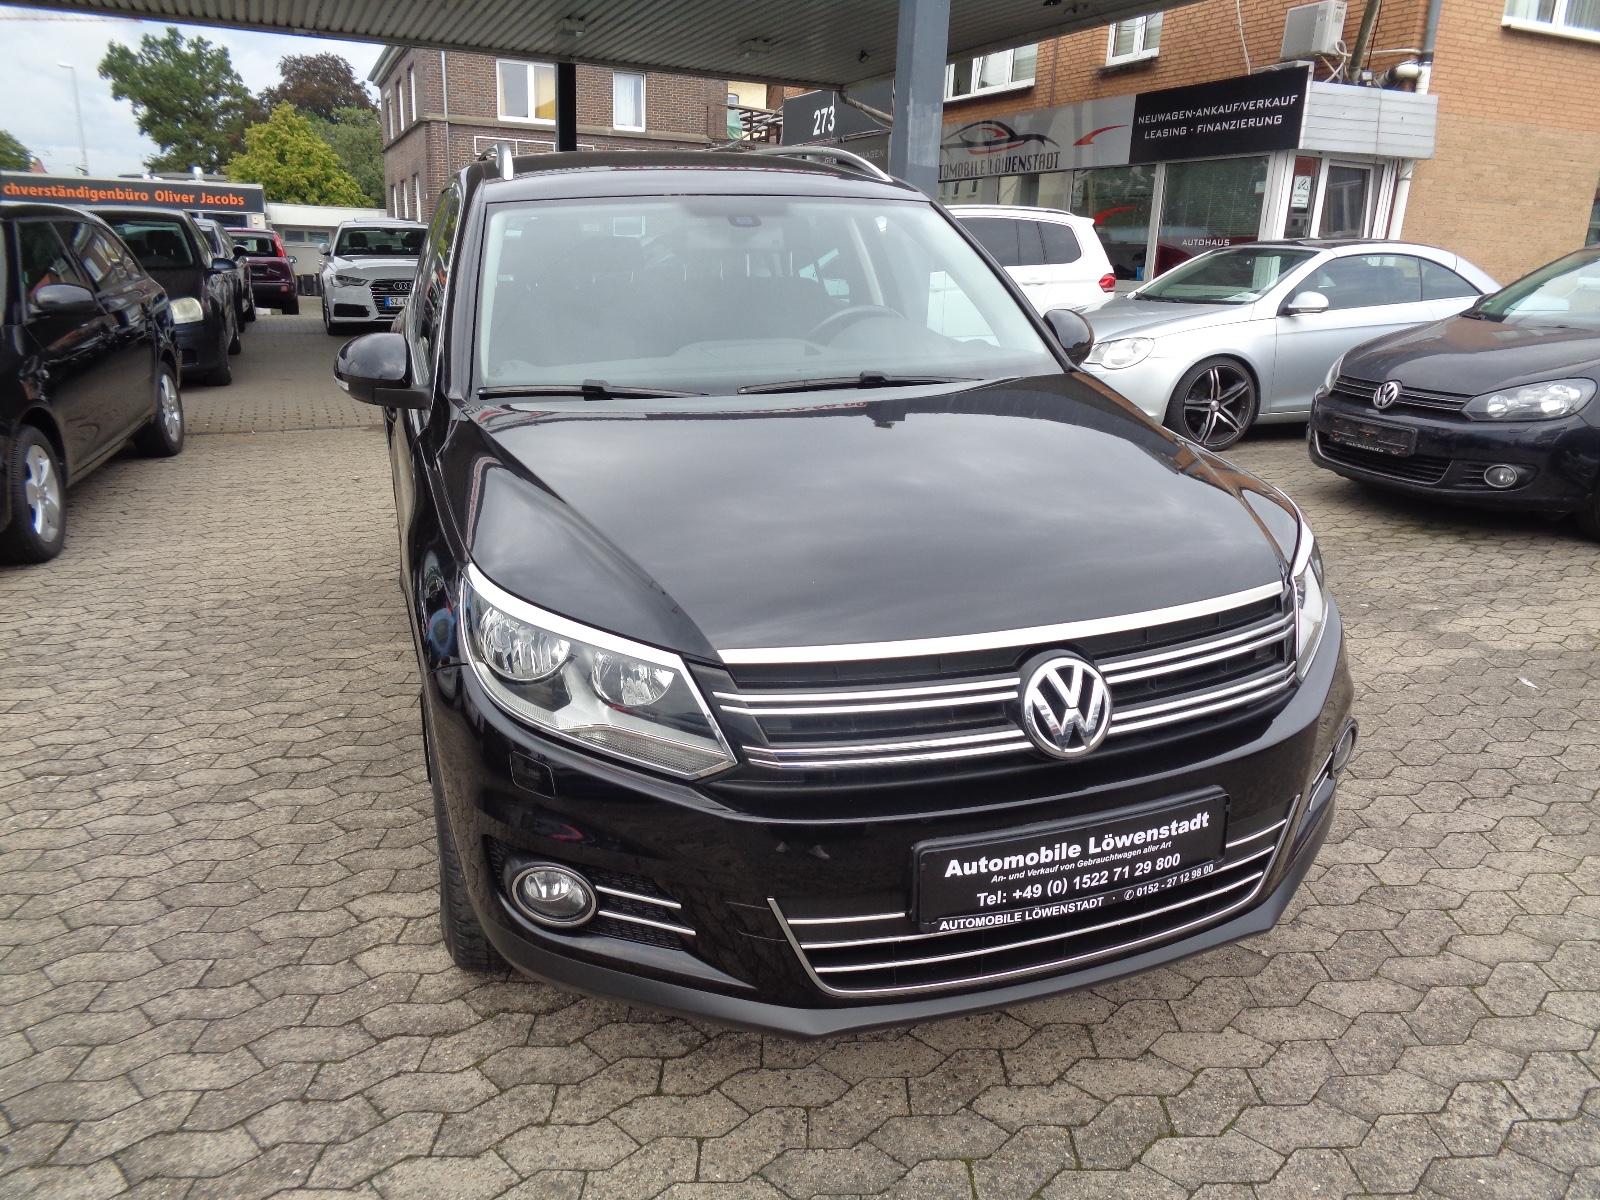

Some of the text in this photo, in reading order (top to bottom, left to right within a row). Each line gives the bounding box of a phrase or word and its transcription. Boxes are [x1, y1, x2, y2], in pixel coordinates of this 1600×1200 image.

[812, 105, 835, 136] 273
[1144, 114, 1282, 139] LEASING FINANZIERUNG
[939, 159, 985, 179] TOMOBILE
[3, 181, 245, 206] chverständigenbüro Oliver Jacobs
[1182, 238, 1230, 246] AUTOHAUS
[944, 811, 1210, 878] Automobile Löwenstadt
[991, 841, 1172, 884] An- und Verkauf von Gebrauchtwagen aller Art
[976, 853, 1181, 907] Tel: +49 (0) 1522 71 29 800
[939, 912, 1022, 931] AUTOMOBILE
[1025, 896, 1105, 921] LÖWENSTADT
[1137, 882, 1159, 897] 0152
[1167, 876, 1177, 887] 27
[1180, 872, 1190, 883] 12
[1191, 868, 1201, 879] 98
[1203, 863, 1214, 874] 00
